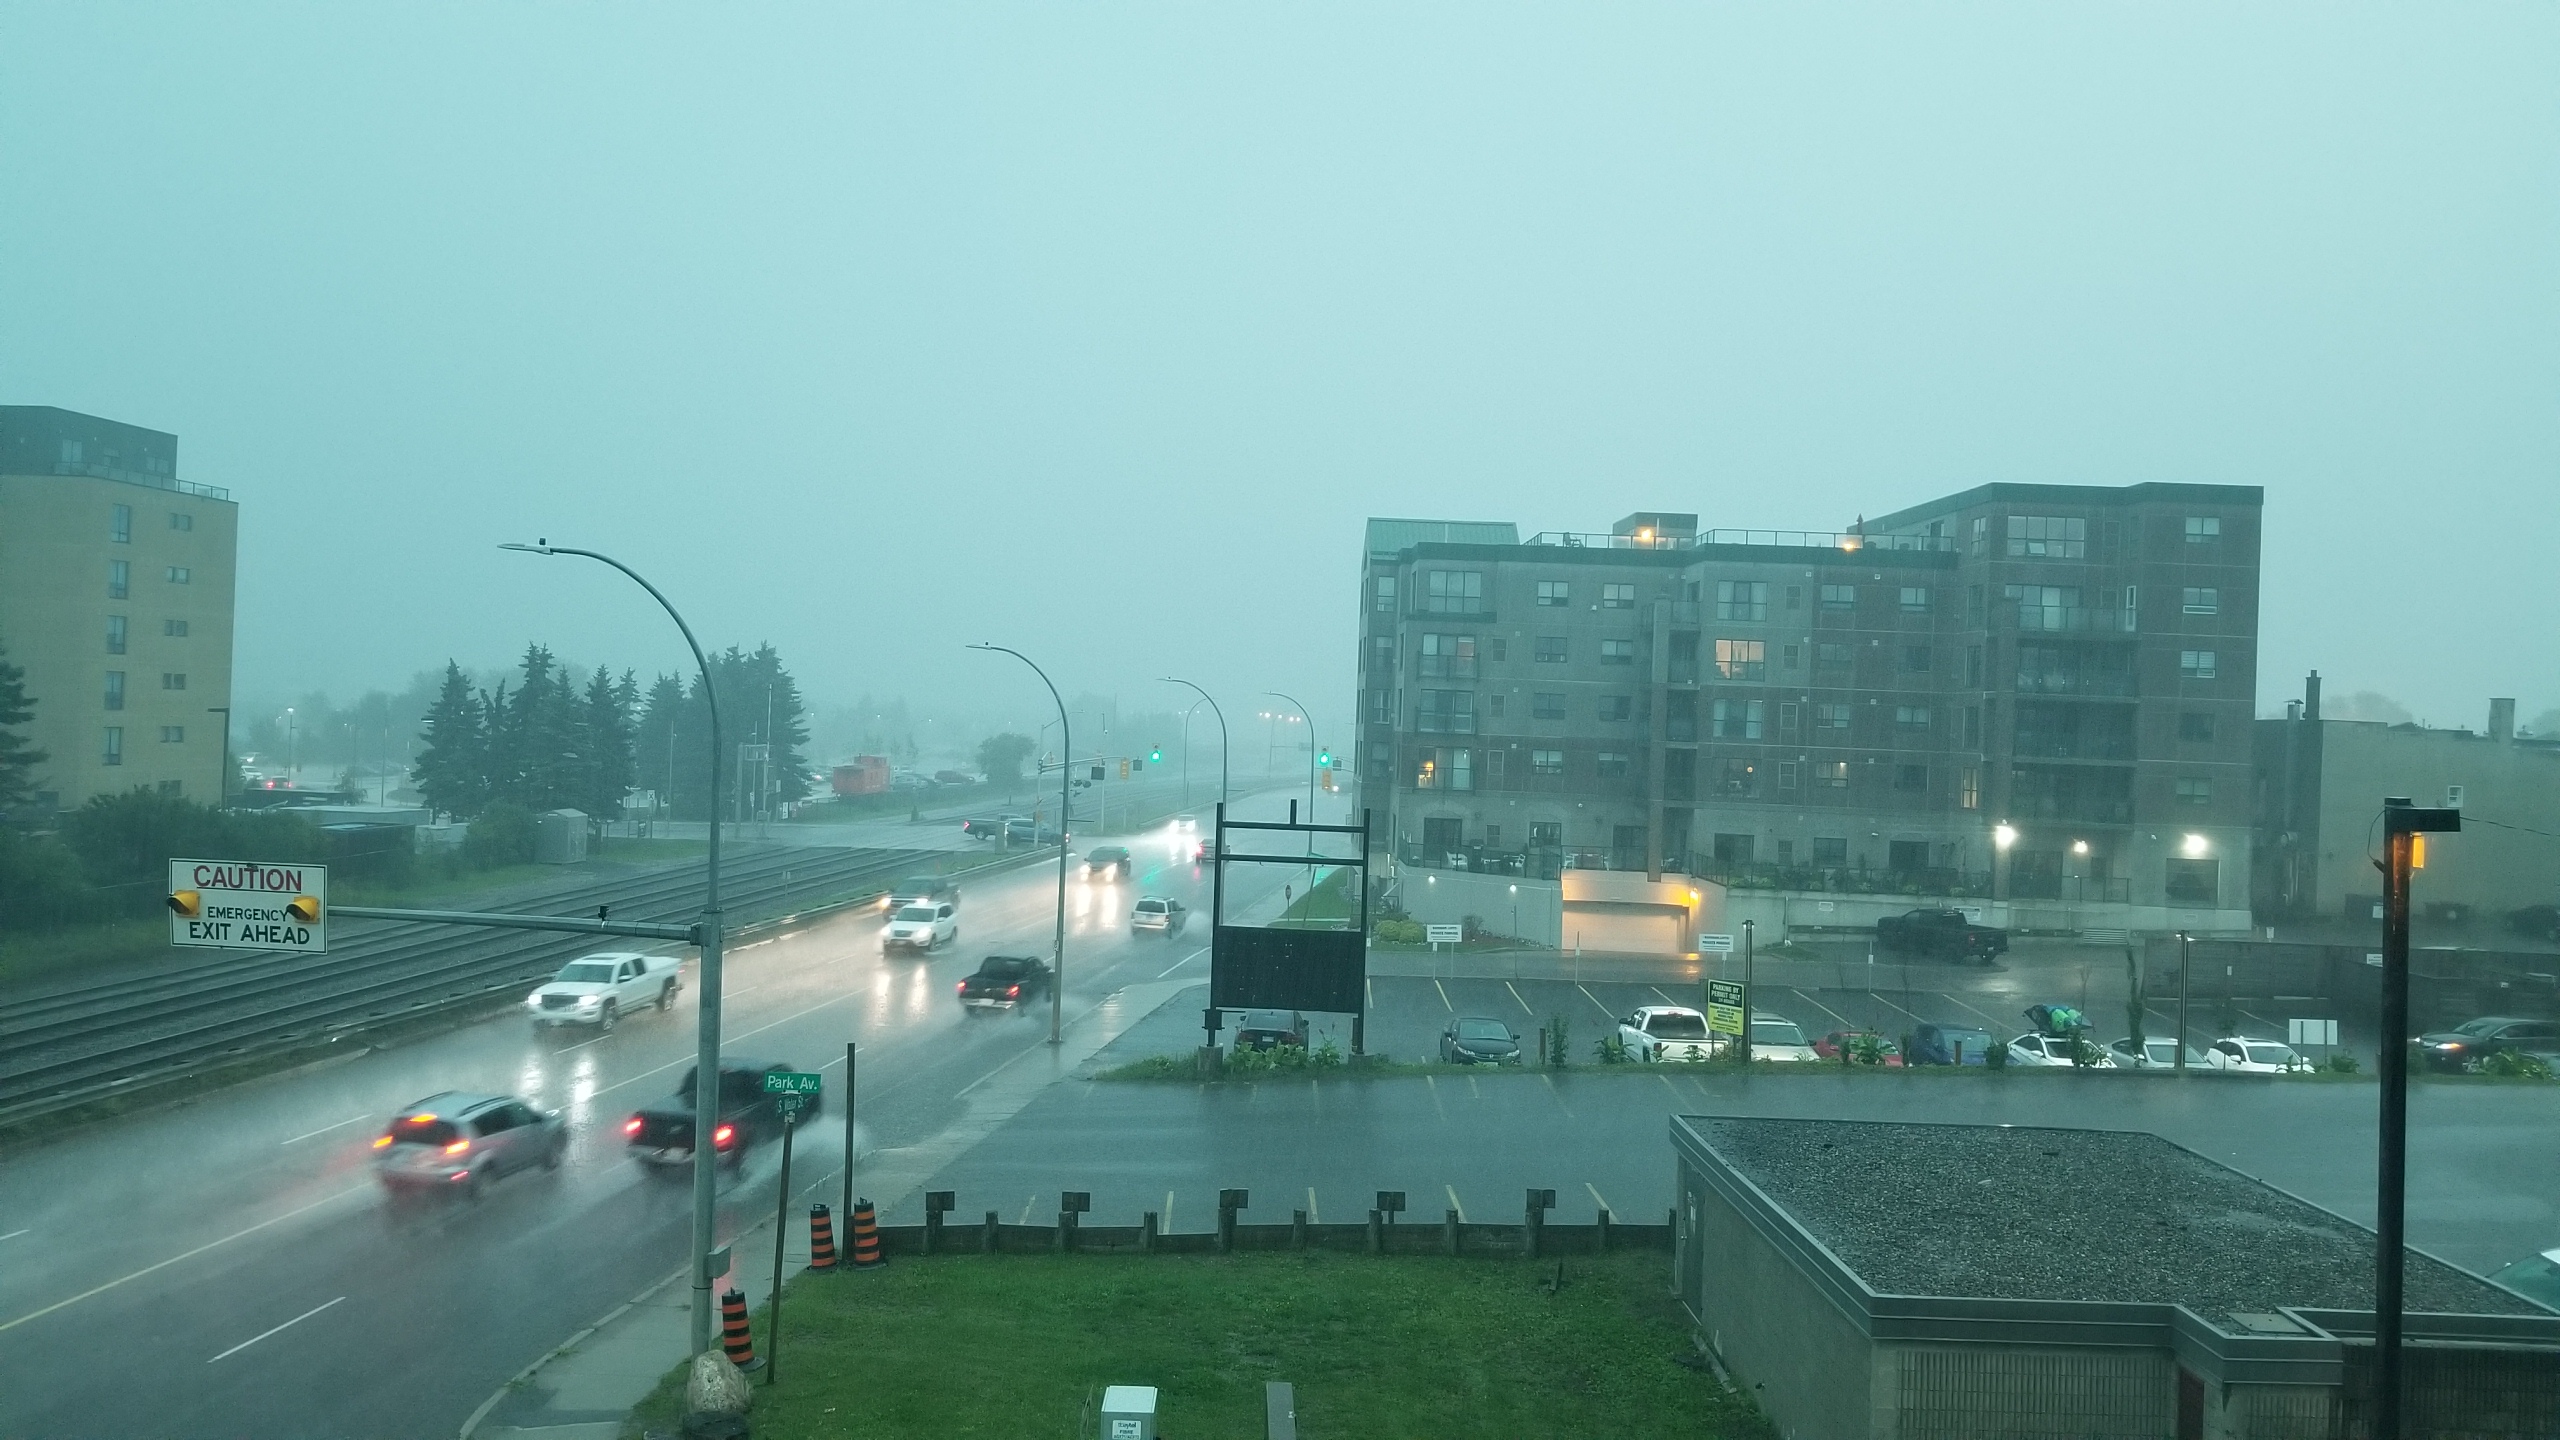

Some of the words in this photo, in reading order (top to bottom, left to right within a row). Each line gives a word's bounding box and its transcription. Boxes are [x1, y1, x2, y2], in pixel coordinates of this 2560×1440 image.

[193, 864, 302, 891] CAUTION
[207, 906, 289, 922] EMERGENCY
[189, 921, 231, 940] EXIT
[240, 924, 310, 944] AHEAD
[1712, 983, 1732, 992] PARKING
[1711, 990, 1729, 998] PERMIT
[1728, 993, 1741, 1001] ONLY
[767, 1075, 794, 1089] Park
[799, 1076, 818, 1090] Av.
